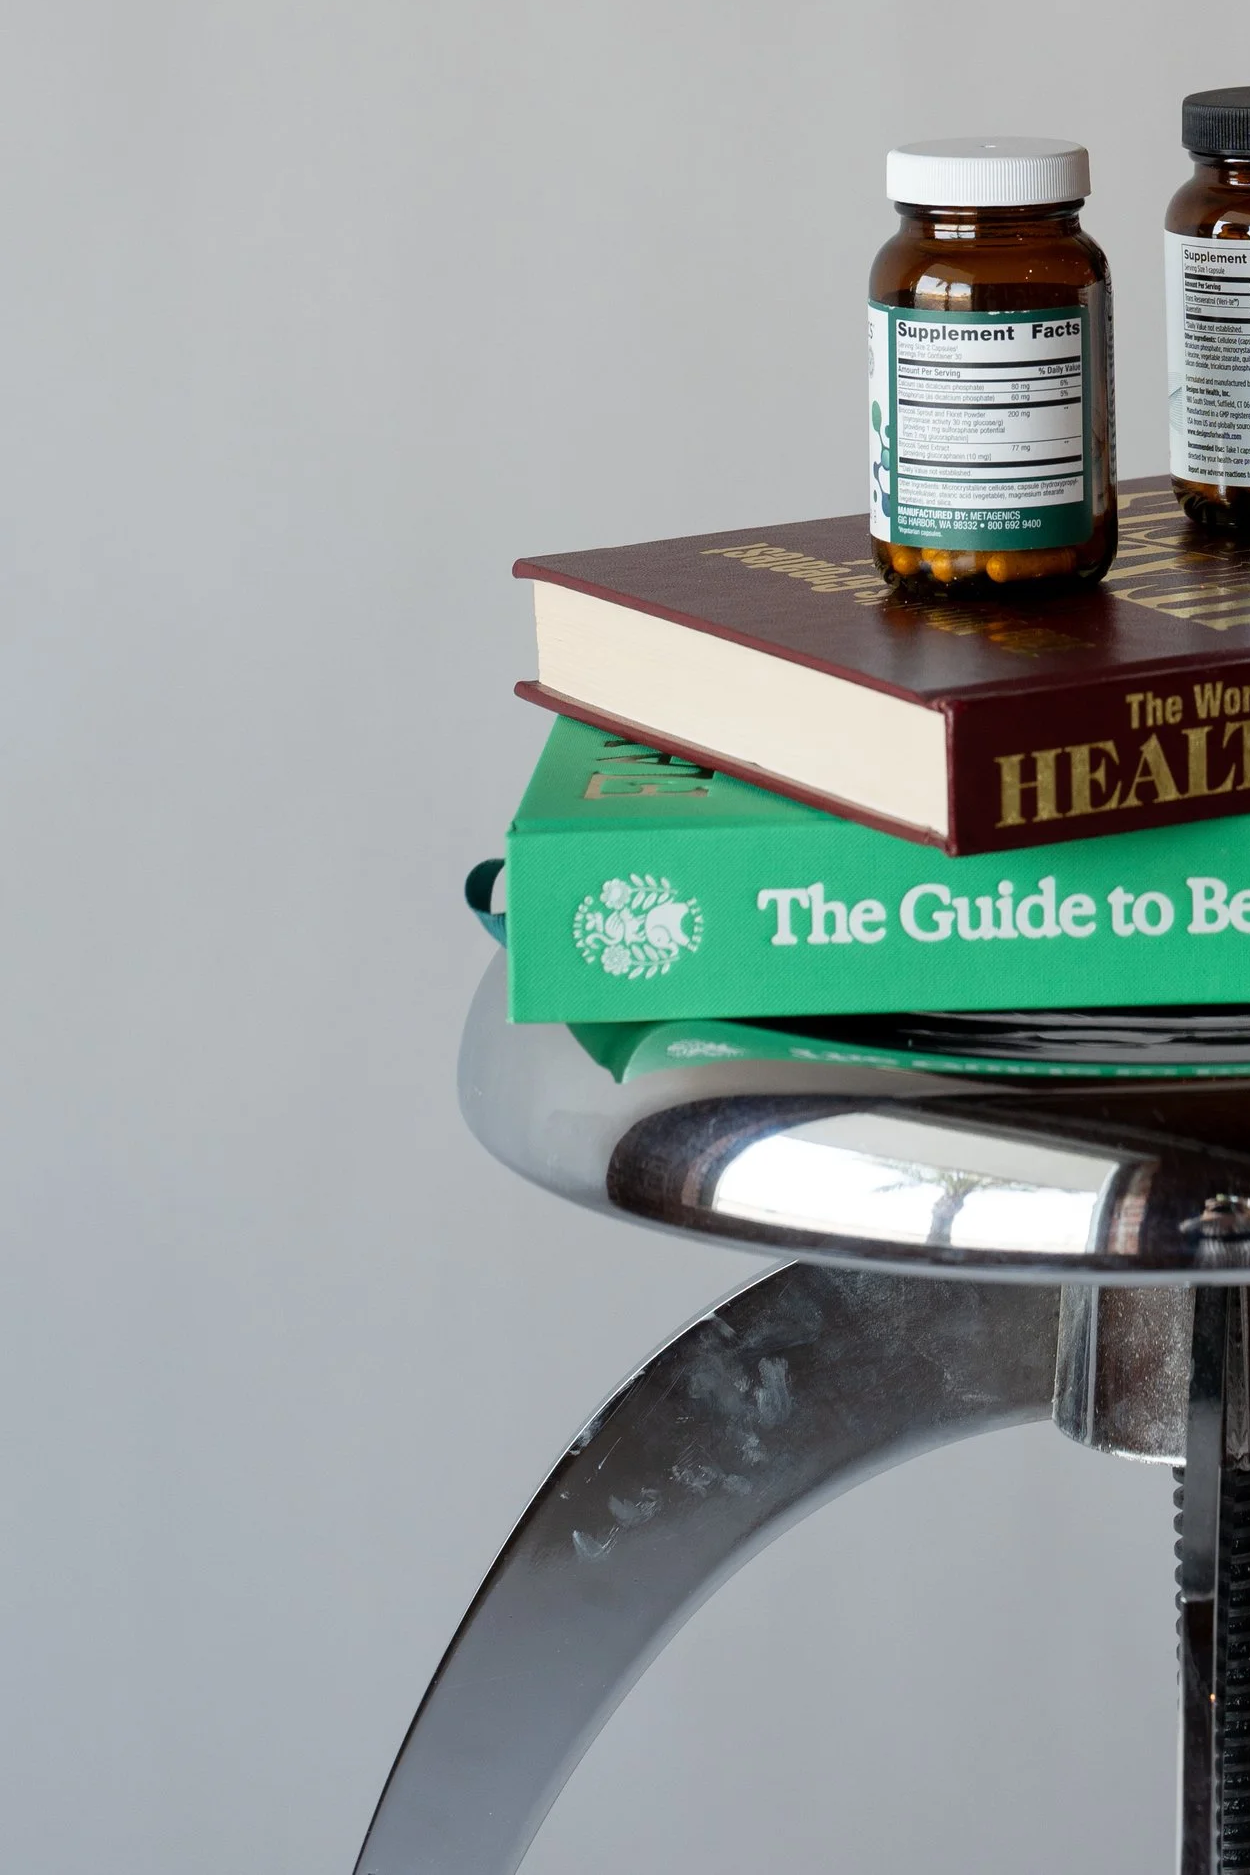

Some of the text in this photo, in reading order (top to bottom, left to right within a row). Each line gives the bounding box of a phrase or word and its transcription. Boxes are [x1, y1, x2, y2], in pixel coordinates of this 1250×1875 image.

[1184, 250, 1247, 264] Supplement
[898, 322, 1015, 342] Supplement
[1031, 321, 1081, 339] Facts
[898, 366, 920, 375] Amount
[934, 370, 961, 378] Serving
[1038, 363, 1081, 375] % Daily Value
[1020, 383, 1030, 391] mg
[1020, 394, 1030, 402] mg
[1007, 410, 1019, 418] 200
[1020, 411, 1030, 419] mg
[1020, 444, 1030, 452] mg
[898, 506, 1021, 520] MANUFACTURED BY: METAGENICS
[898, 515, 1042, 530] GIG HARBOR, WA 98332 800 692 9400
[1126, 691, 1184, 730] The
[757, 881, 887, 946] The
[900, 875, 1097, 943] Guide
[1107, 885, 1175, 937] to
